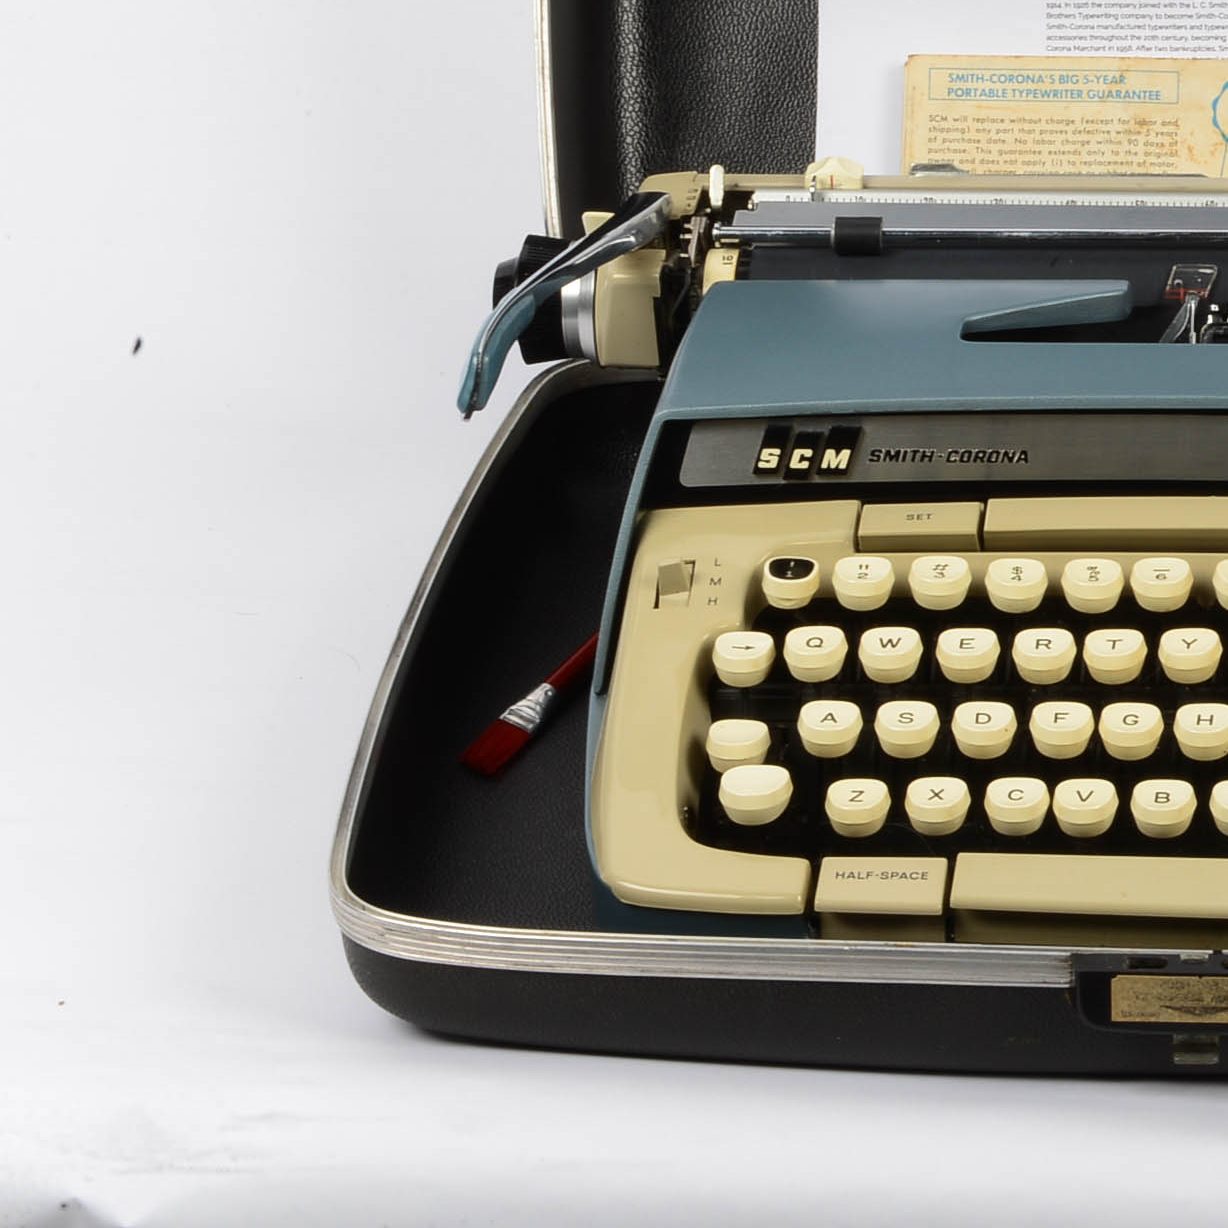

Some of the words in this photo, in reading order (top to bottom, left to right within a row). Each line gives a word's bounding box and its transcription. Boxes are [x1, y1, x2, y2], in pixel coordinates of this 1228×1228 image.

[947, 73, 1056, 84] SMITH-CORONA'S
[1058, 74, 1080, 84] BIG
[1081, 75, 1127, 85] 5-YEAR
[946, 87, 1009, 99] PORTABLE
[1009, 88, 1084, 101] TYPEWRITER
[1085, 89, 1162, 102] GUARANTEE
[756, 448, 852, 471] SCM
[869, 449, 1028, 463] SMITH-CORONA
[714, 558, 721, 566] L
[709, 577, 722, 586] M
[857, 572, 869, 580] 2
[708, 597, 718, 605] H
[806, 637, 823, 648] Q
[880, 637, 901, 648] W
[959, 638, 975, 649] E
[1035, 639, 1051, 649] R
[1107, 639, 1123, 649] T
[1182, 639, 1198, 649] Y
[820, 712, 837, 723] A
[898, 712, 914, 724] S
[975, 713, 991, 724] D
[1053, 713, 1069, 724] F
[1122, 714, 1139, 726] G
[1197, 714, 1213, 726] H
[848, 790, 864, 802] Z
[928, 788, 945, 800] X
[1007, 789, 1024, 801] C
[1077, 791, 1093, 802] V
[1154, 792, 1170, 803] B
[835, 871, 929, 881] HALF-SPACE
